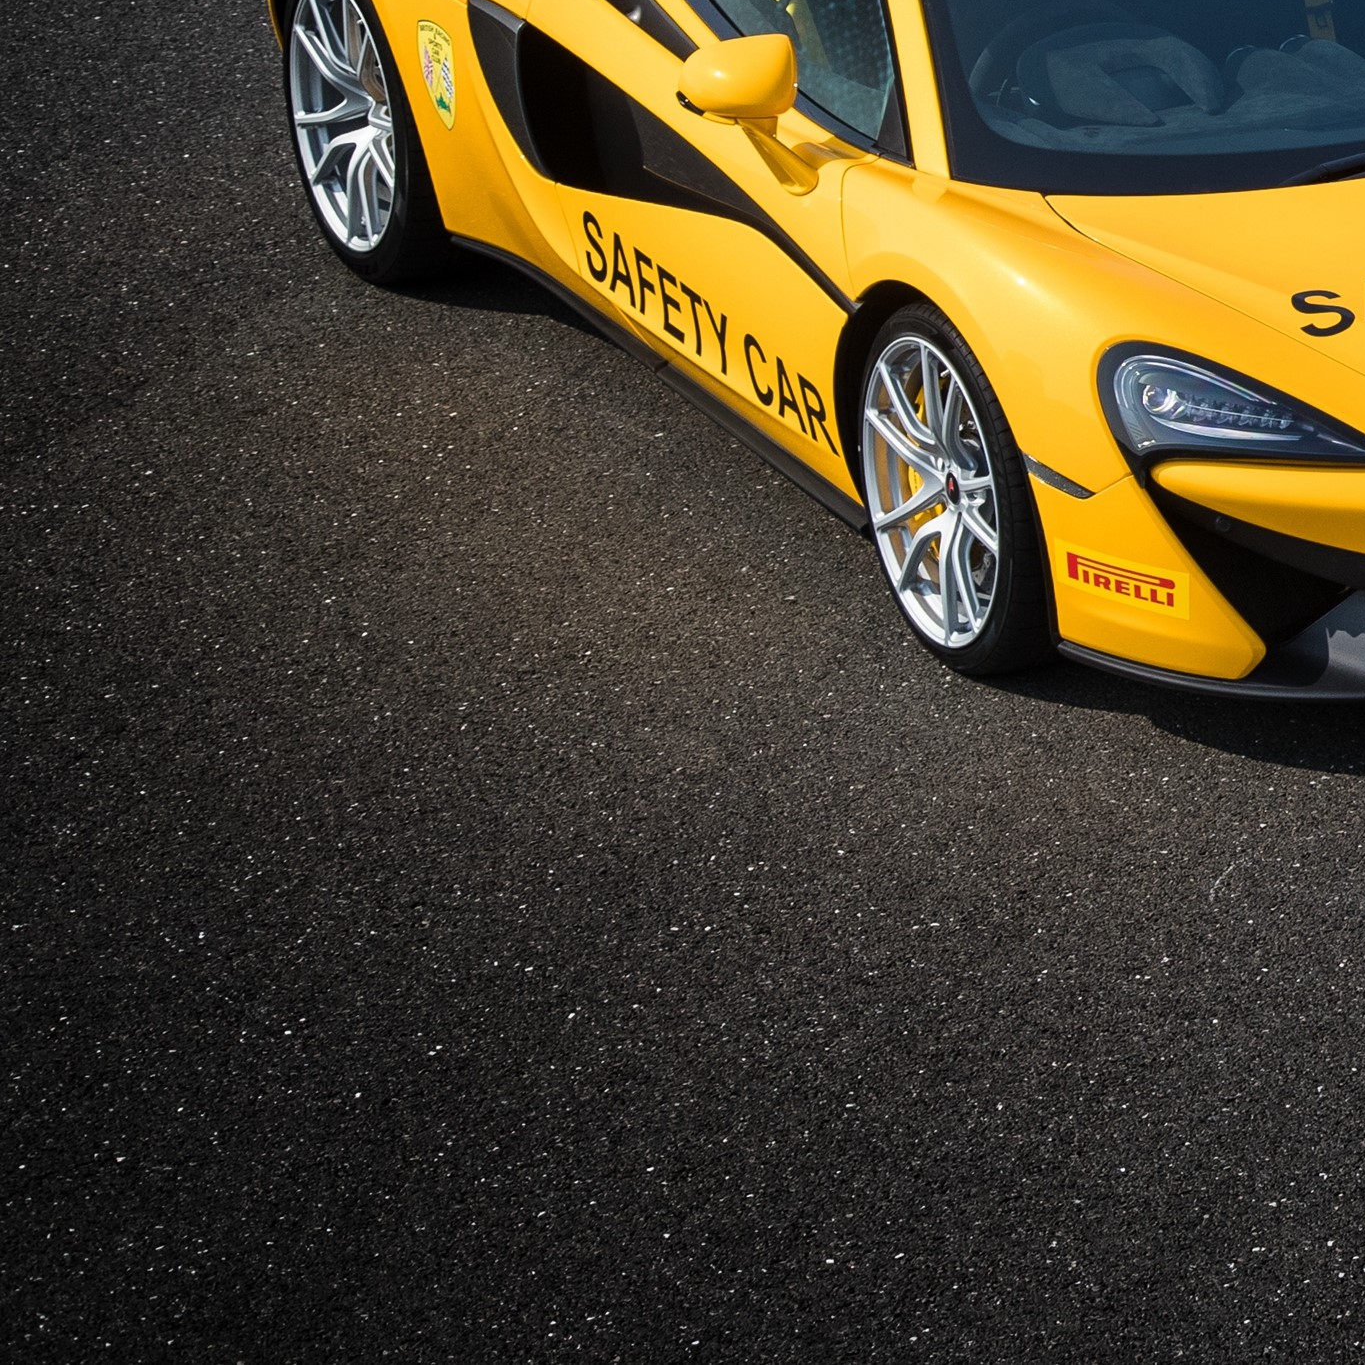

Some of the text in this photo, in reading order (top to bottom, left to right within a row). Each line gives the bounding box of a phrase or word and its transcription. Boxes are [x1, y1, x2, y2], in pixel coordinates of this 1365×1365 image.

[583, 211, 840, 457] SAFETY CAR
[1066, 551, 1176, 608] PIRELLI
